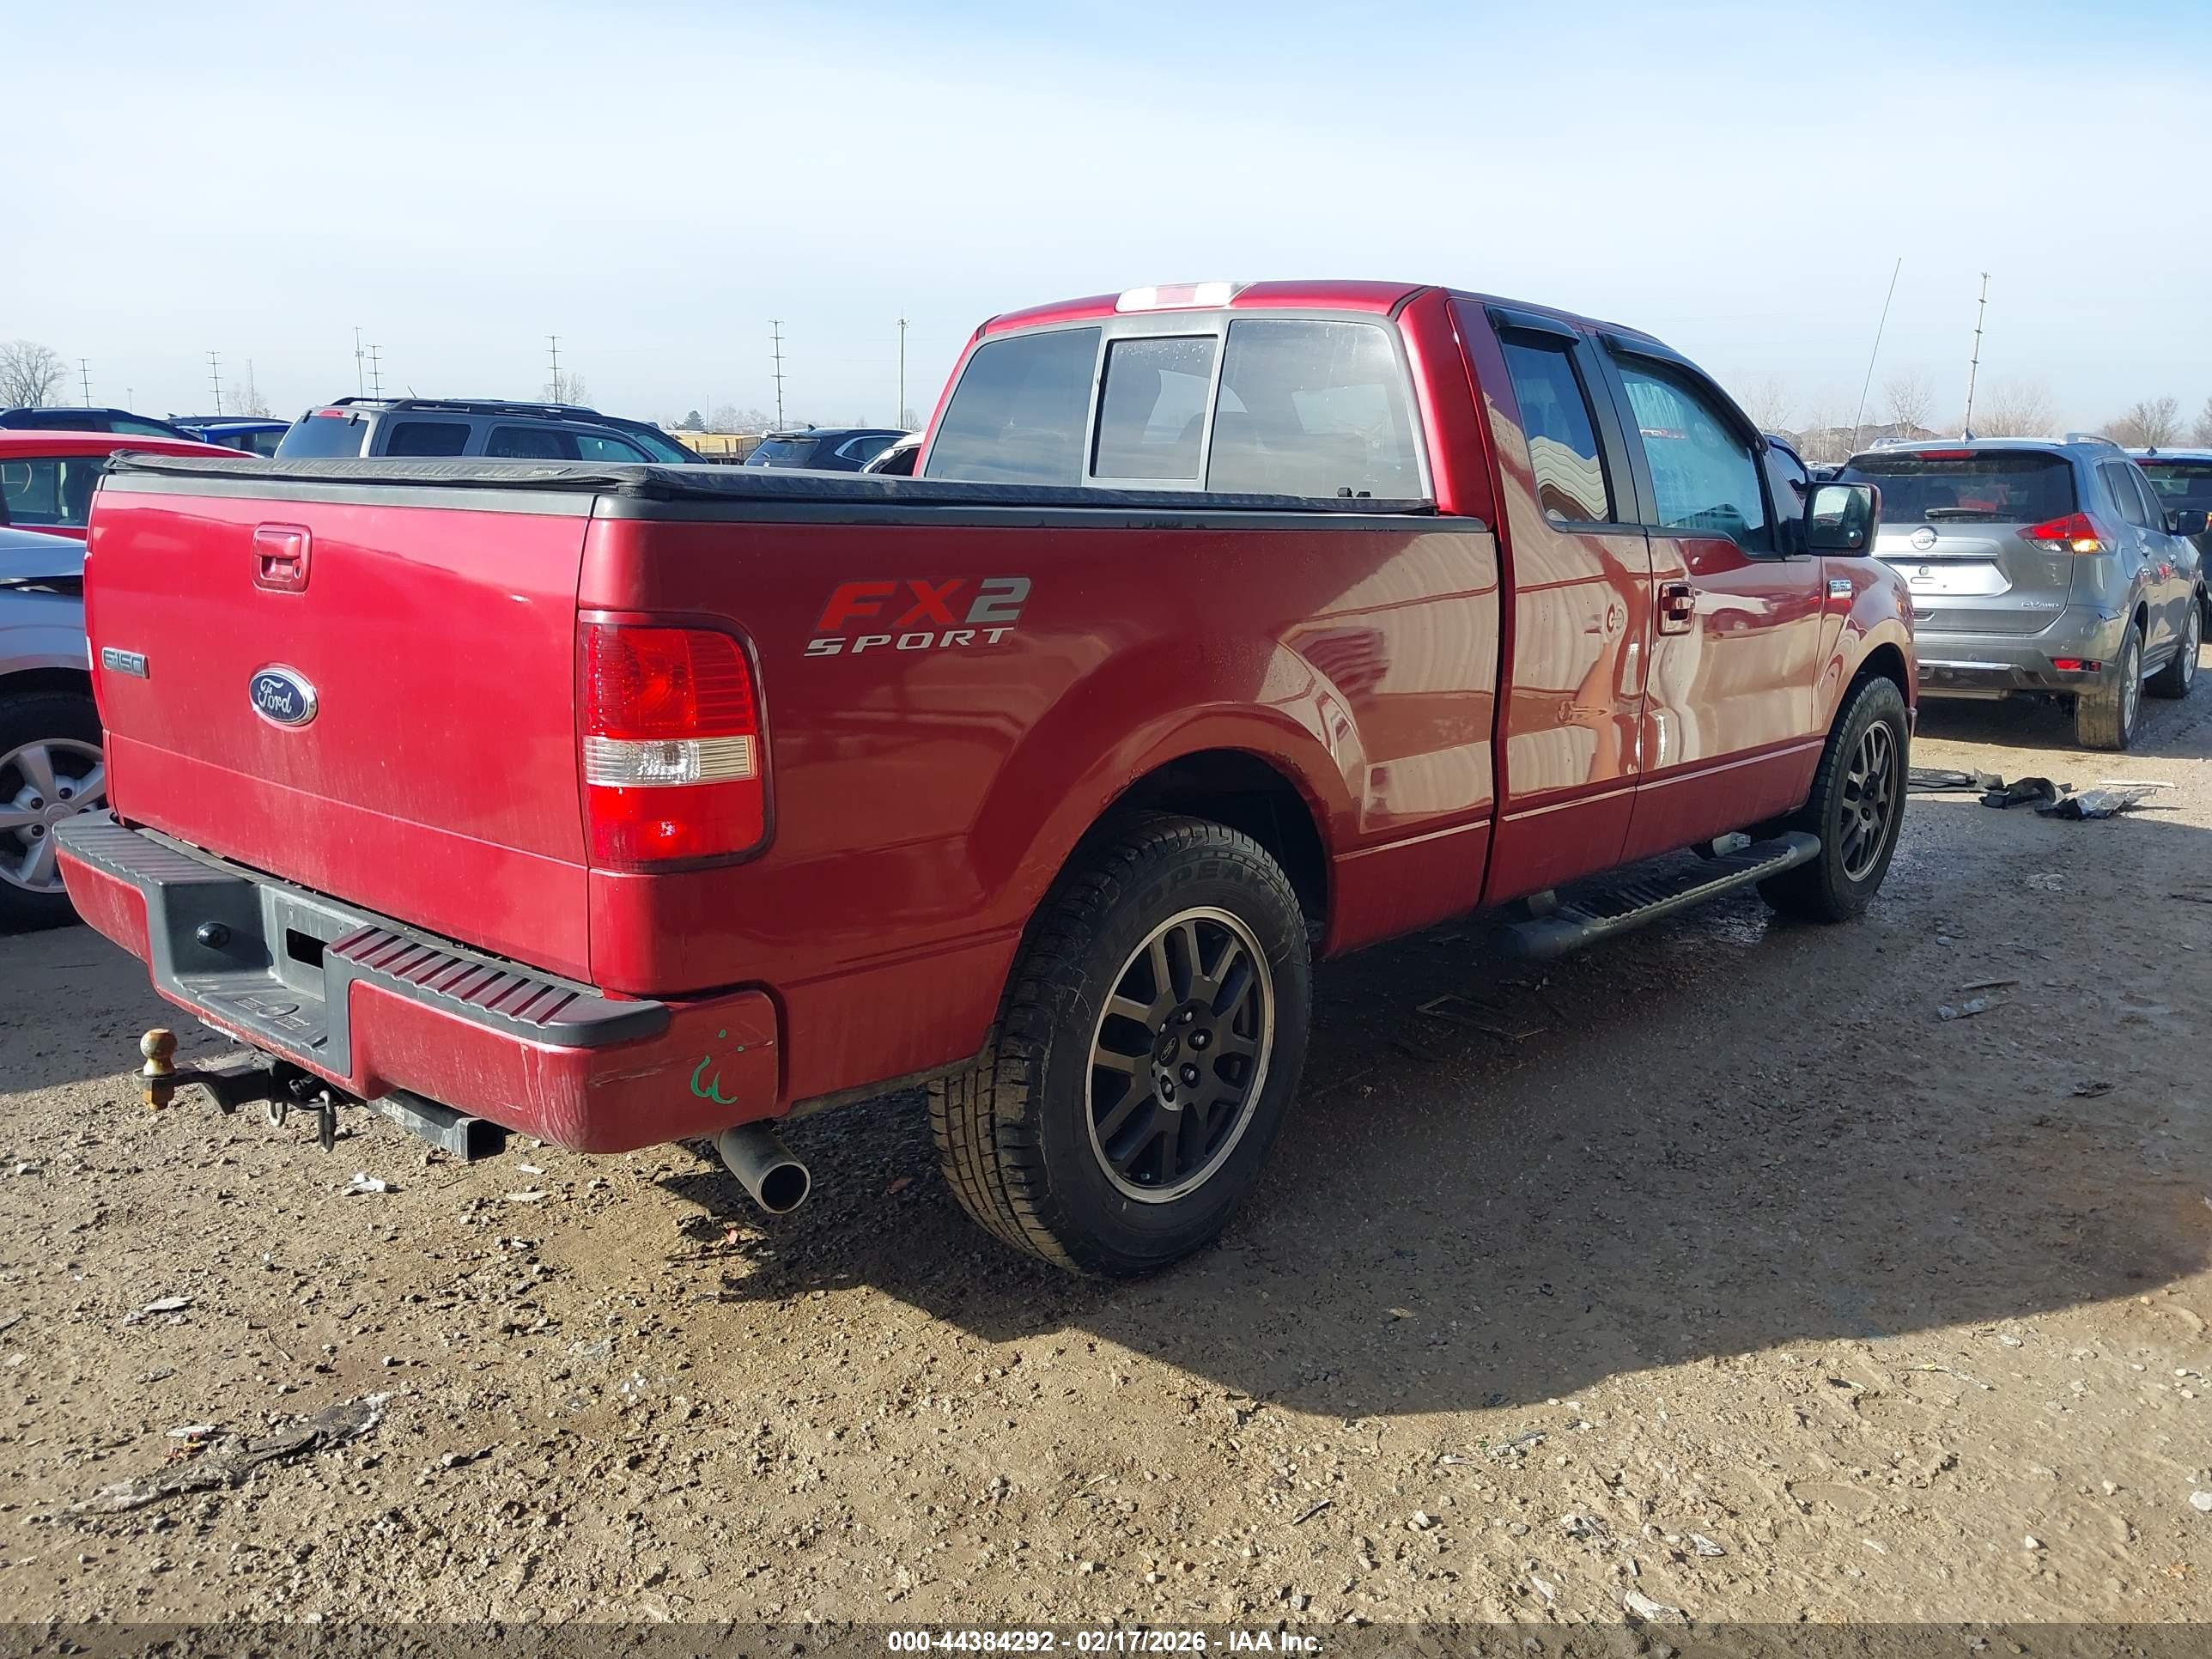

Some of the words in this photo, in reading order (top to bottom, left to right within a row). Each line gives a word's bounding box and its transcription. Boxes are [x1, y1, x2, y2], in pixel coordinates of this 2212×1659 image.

[817, 576, 1031, 632] FX2
[804, 627, 1015, 657] SPORT
[258, 678, 293, 714] Ford
